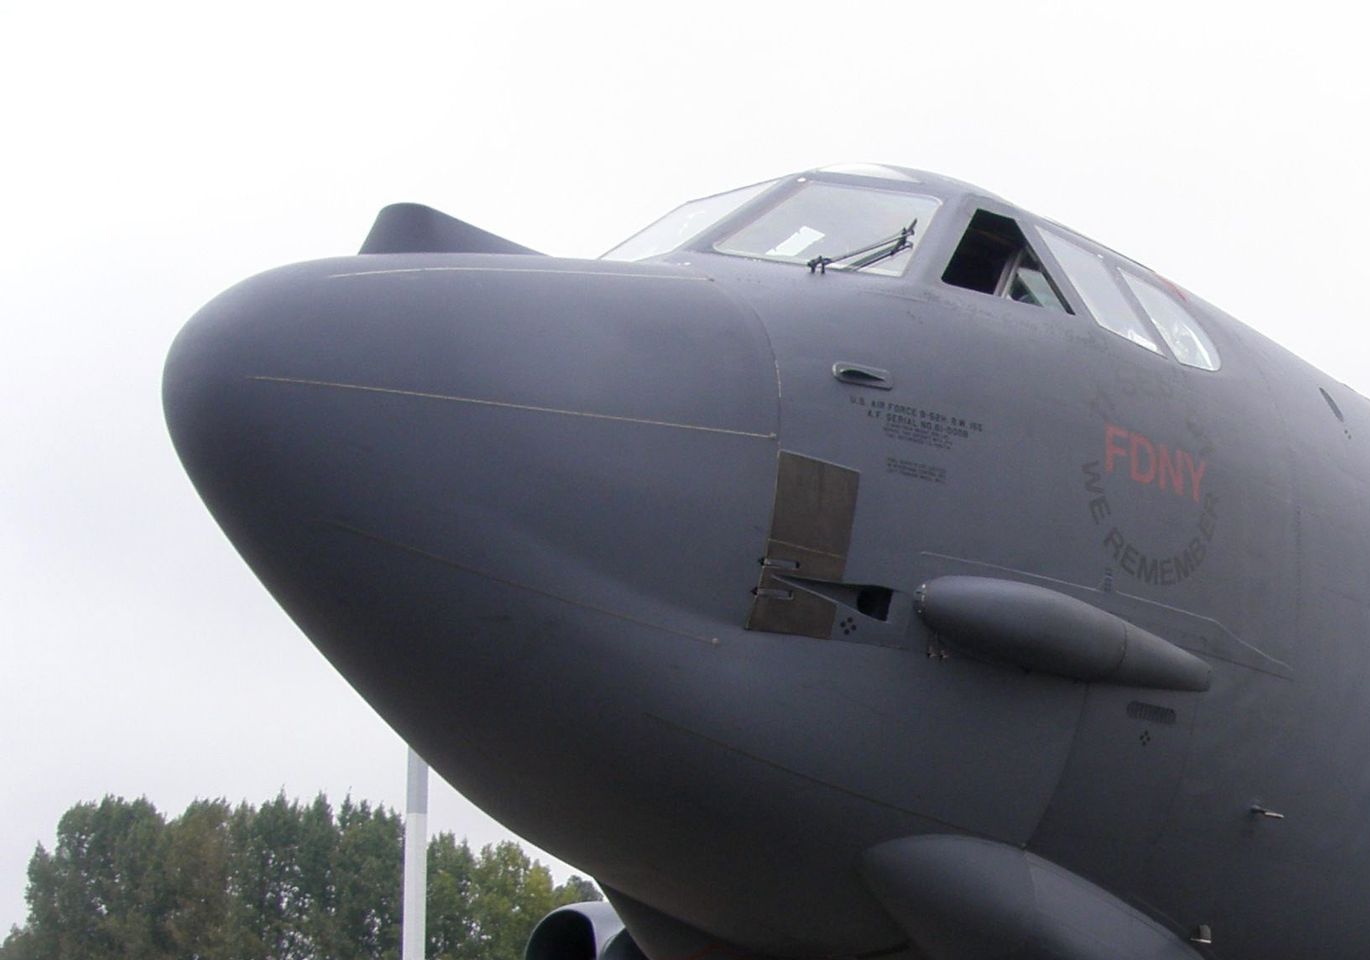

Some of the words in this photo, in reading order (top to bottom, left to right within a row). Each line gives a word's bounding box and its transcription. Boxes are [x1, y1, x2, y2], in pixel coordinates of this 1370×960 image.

[871, 401, 885, 409] AIR
[888, 403, 917, 416] FORCE
[886, 413, 917, 427] SERIAL
[1104, 424, 1206, 503] FDNY
[1081, 460, 1112, 525] WE
[1103, 492, 1220, 586] REMEMBER
